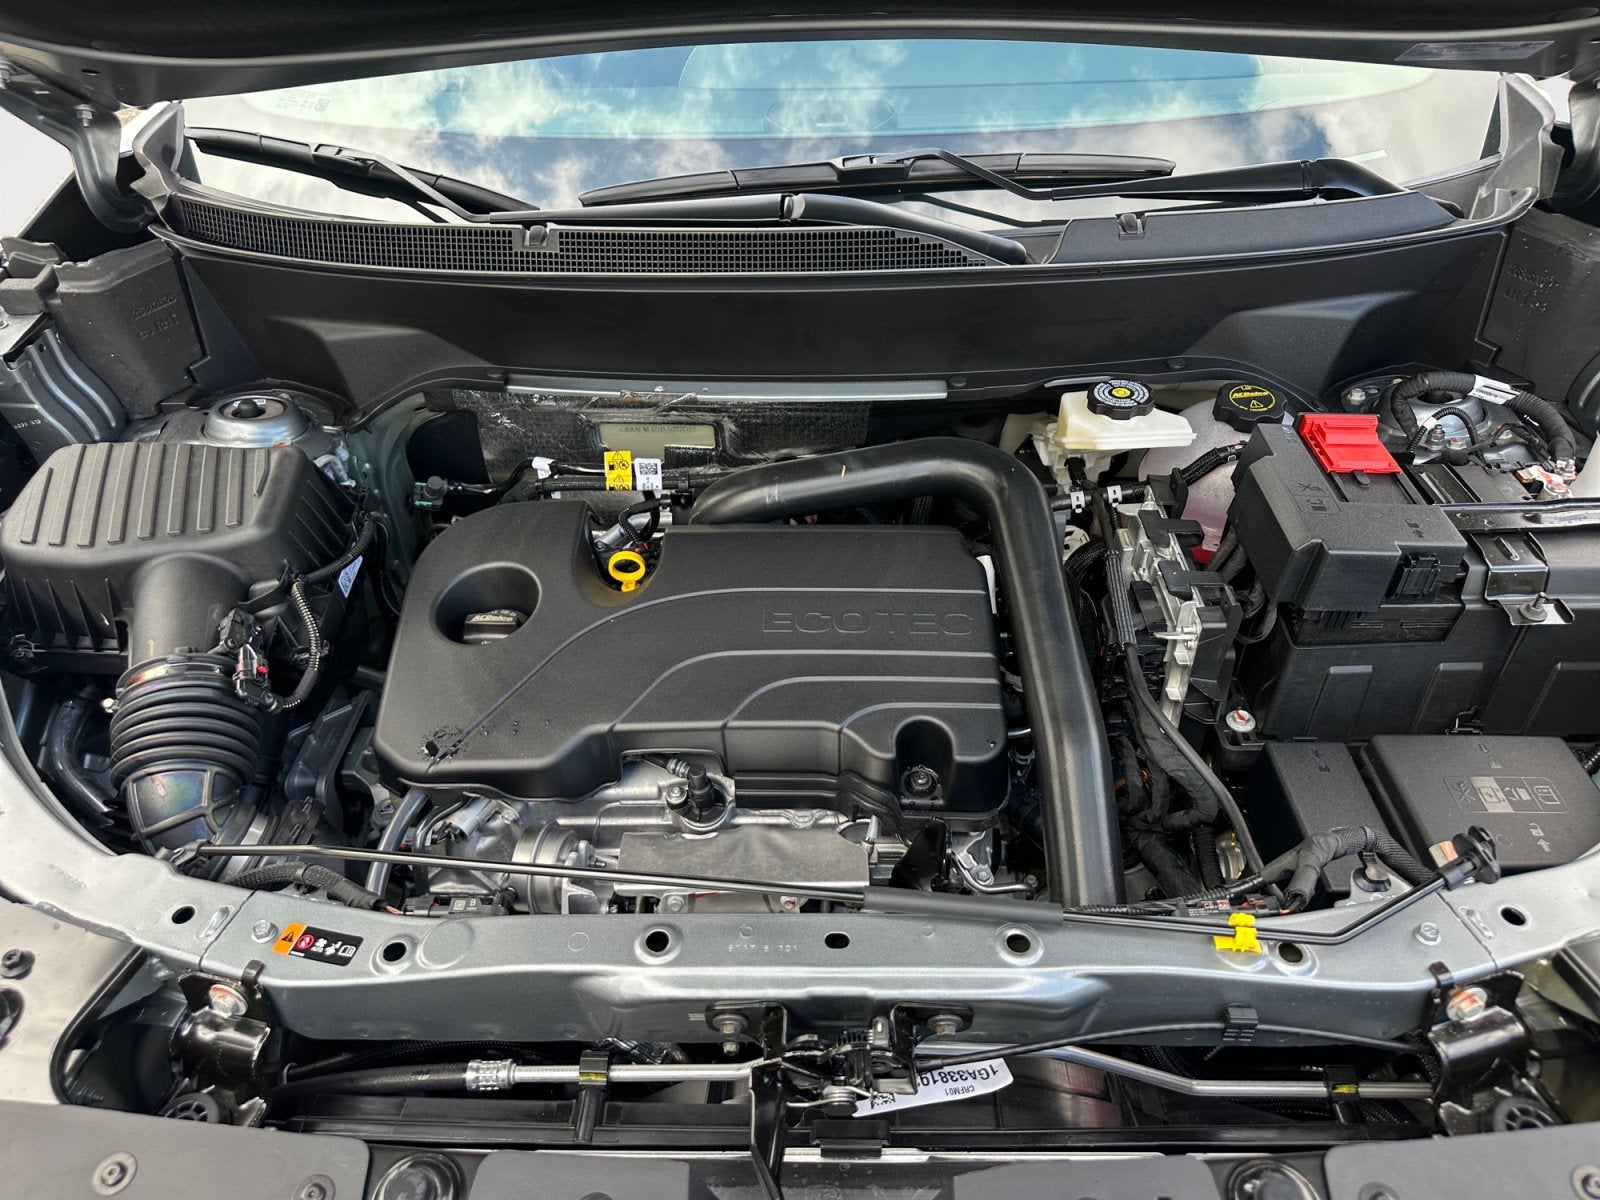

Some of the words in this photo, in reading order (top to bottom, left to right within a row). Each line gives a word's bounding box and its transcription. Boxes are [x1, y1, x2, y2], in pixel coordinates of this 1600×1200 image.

[1232, 391, 1269, 399] ACDelco
[470, 614, 514, 622] ACDelco
[762, 609, 975, 636] ECOTEC
[469, 898, 477, 907] B
[917, 1064, 999, 1087] 1GA33819
[945, 1084, 975, 1097] CRFM01
